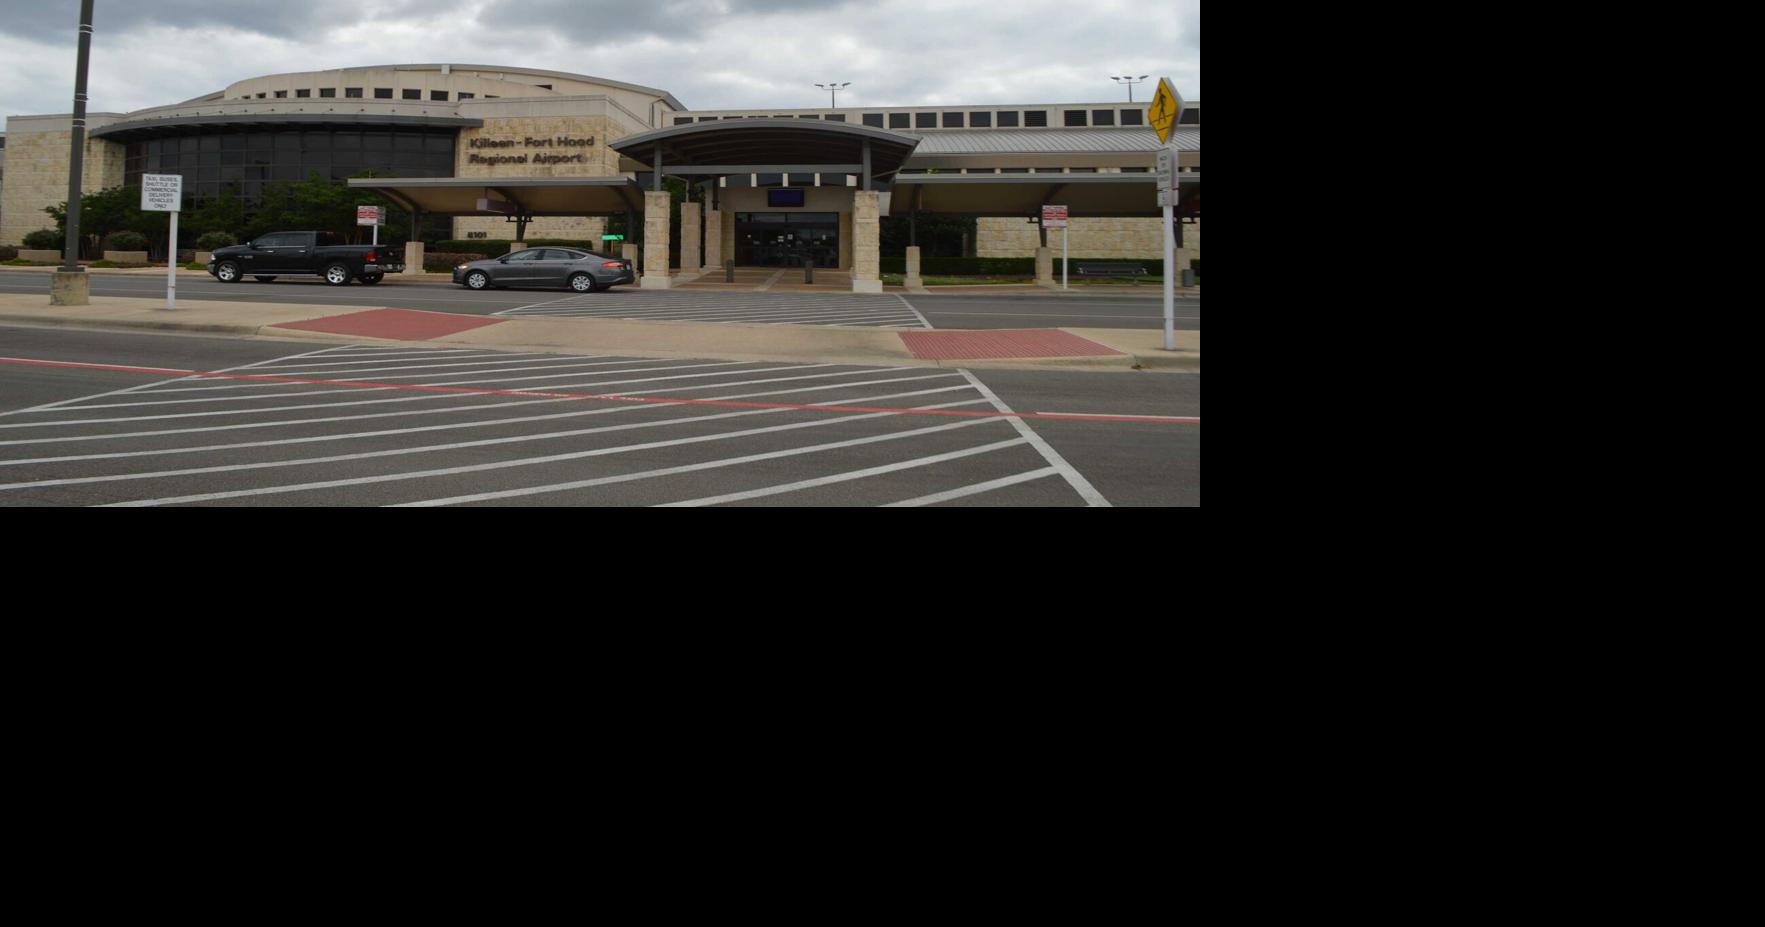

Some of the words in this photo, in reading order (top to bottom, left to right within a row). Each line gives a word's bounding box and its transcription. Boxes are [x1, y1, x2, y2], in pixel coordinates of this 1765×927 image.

[557, 135, 595, 147] Hood
[470, 153, 528, 165] Regional
[532, 153, 583, 165] Airport
